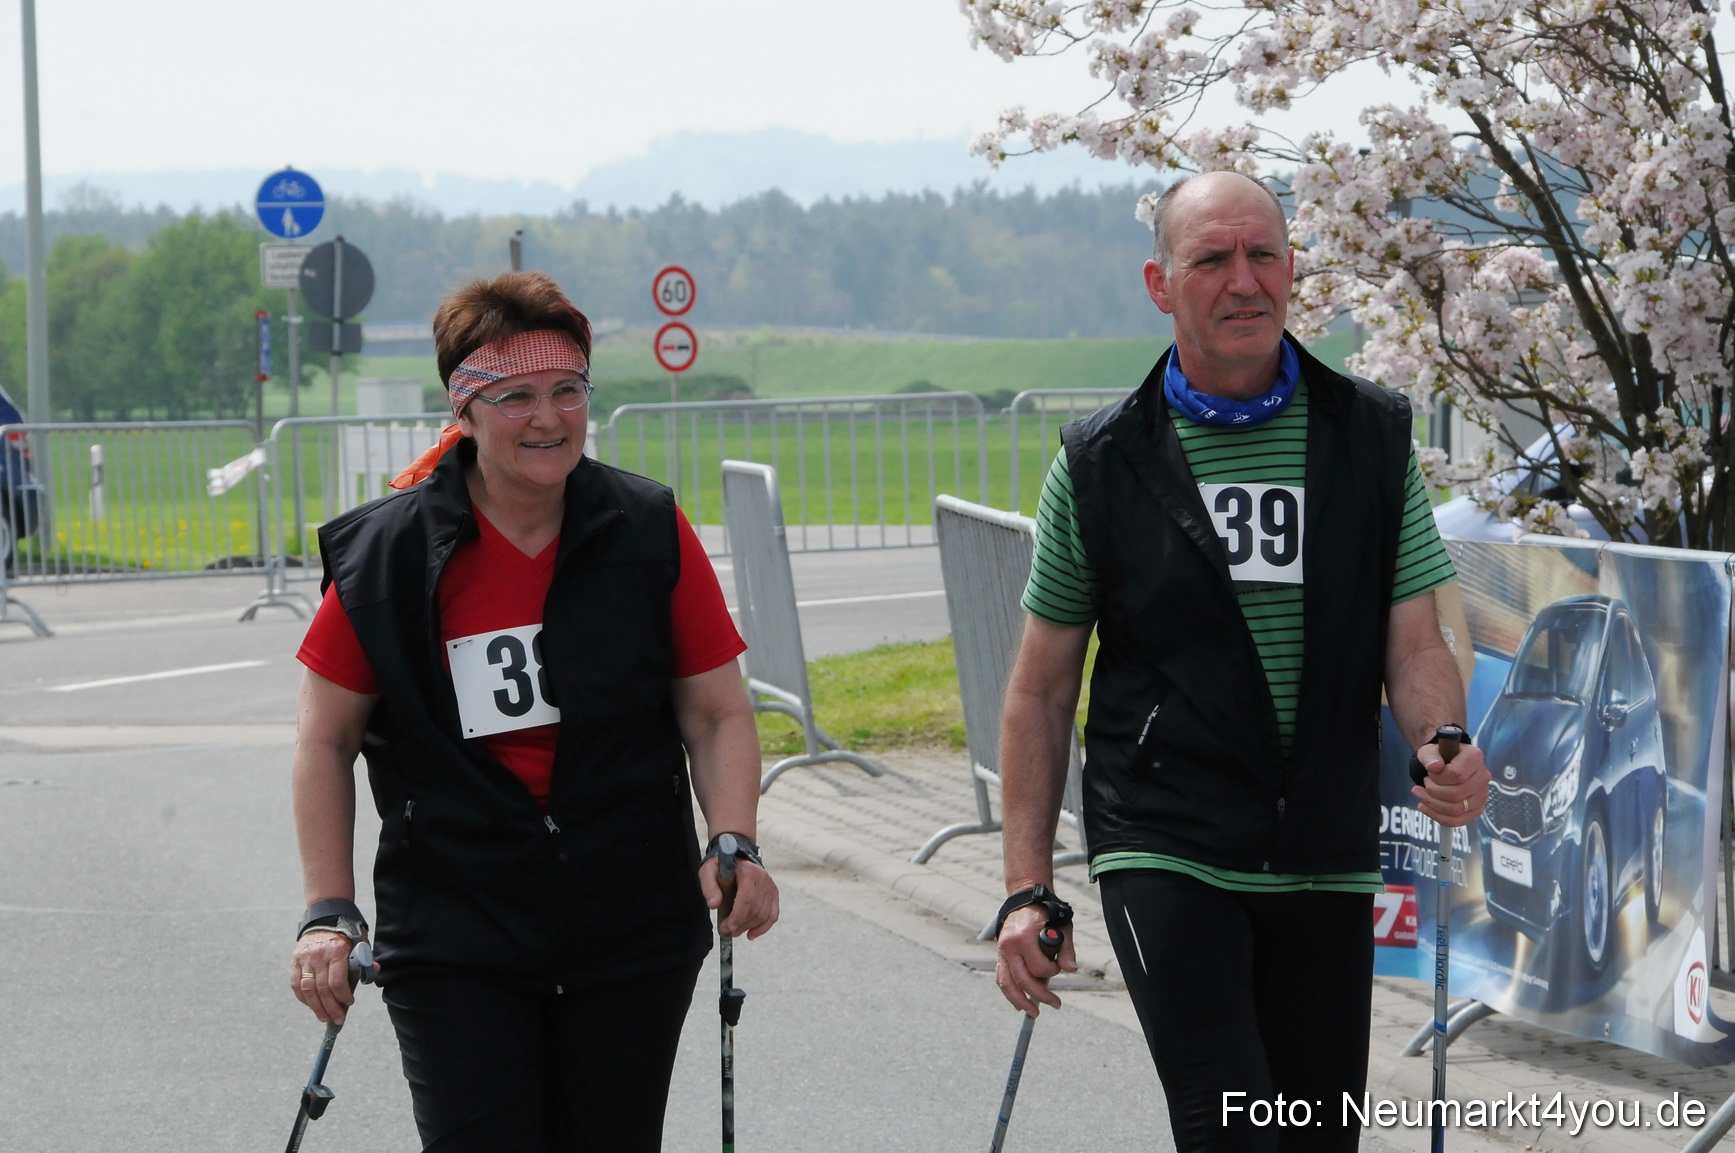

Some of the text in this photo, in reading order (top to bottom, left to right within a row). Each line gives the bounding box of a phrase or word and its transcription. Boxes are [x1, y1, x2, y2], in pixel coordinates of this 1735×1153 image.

[662, 279, 687, 303] 60
[1214, 486, 1299, 568] 39
[1374, 892, 1405, 939] 7
